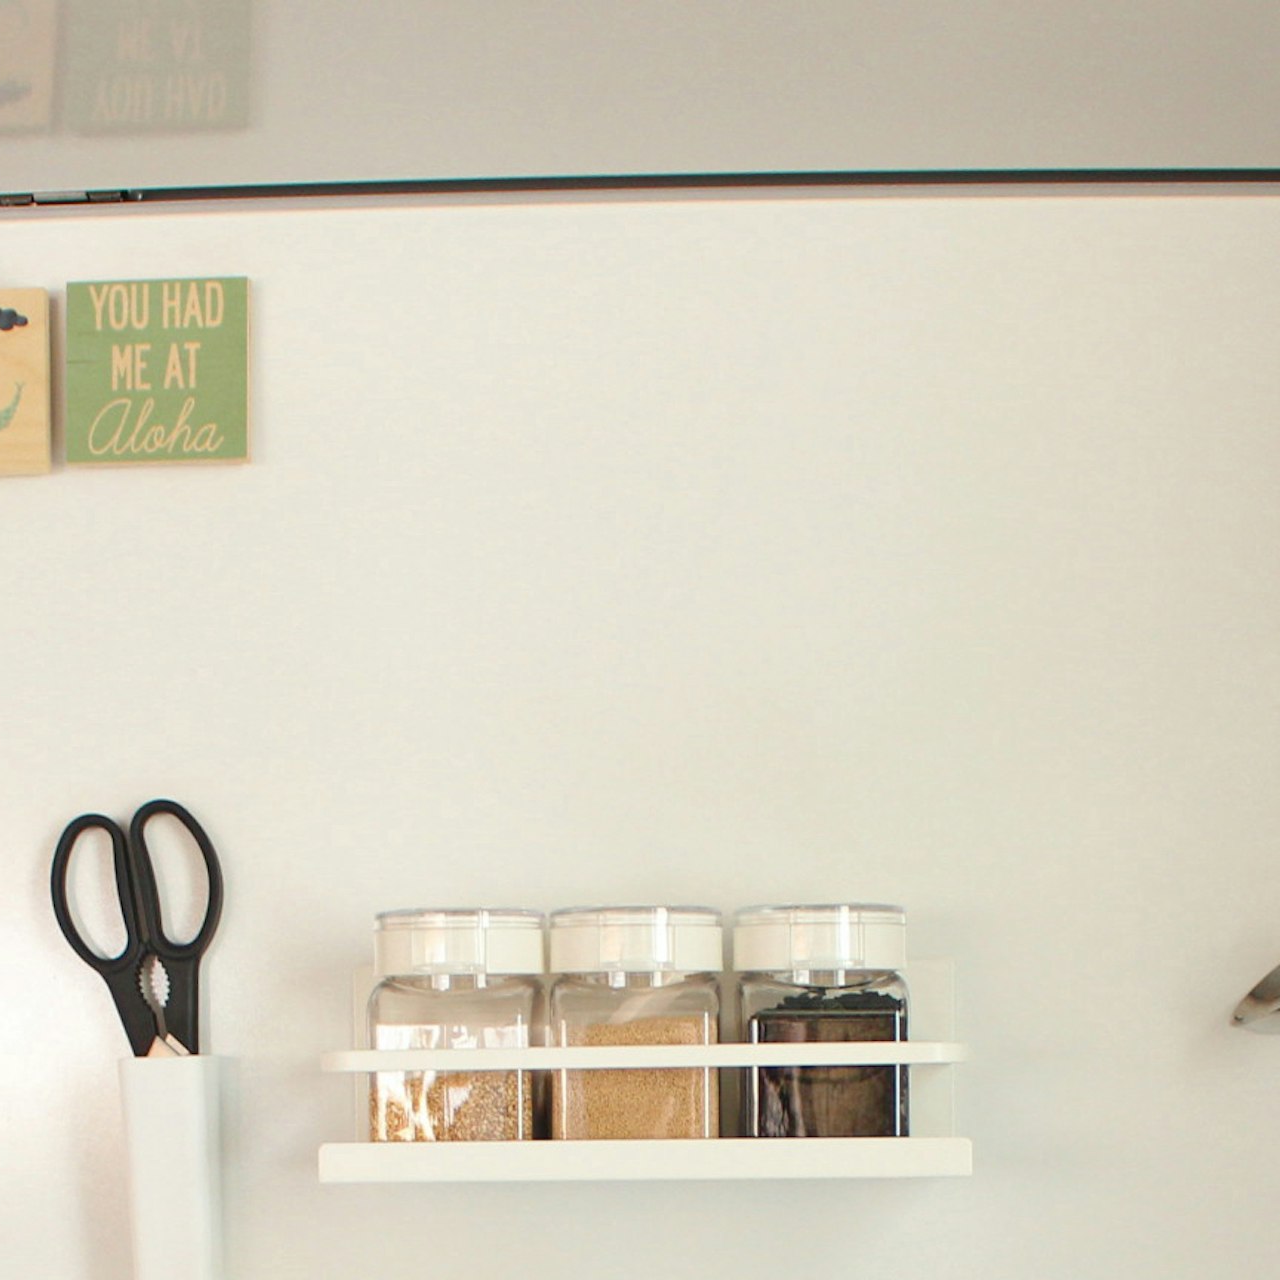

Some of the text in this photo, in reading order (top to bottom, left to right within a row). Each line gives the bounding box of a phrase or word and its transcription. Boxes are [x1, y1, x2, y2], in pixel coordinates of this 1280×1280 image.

[89, 281, 224, 331] YOU HAD
[111, 342, 201, 391] ME AT
[87, 398, 225, 456] Aloha
